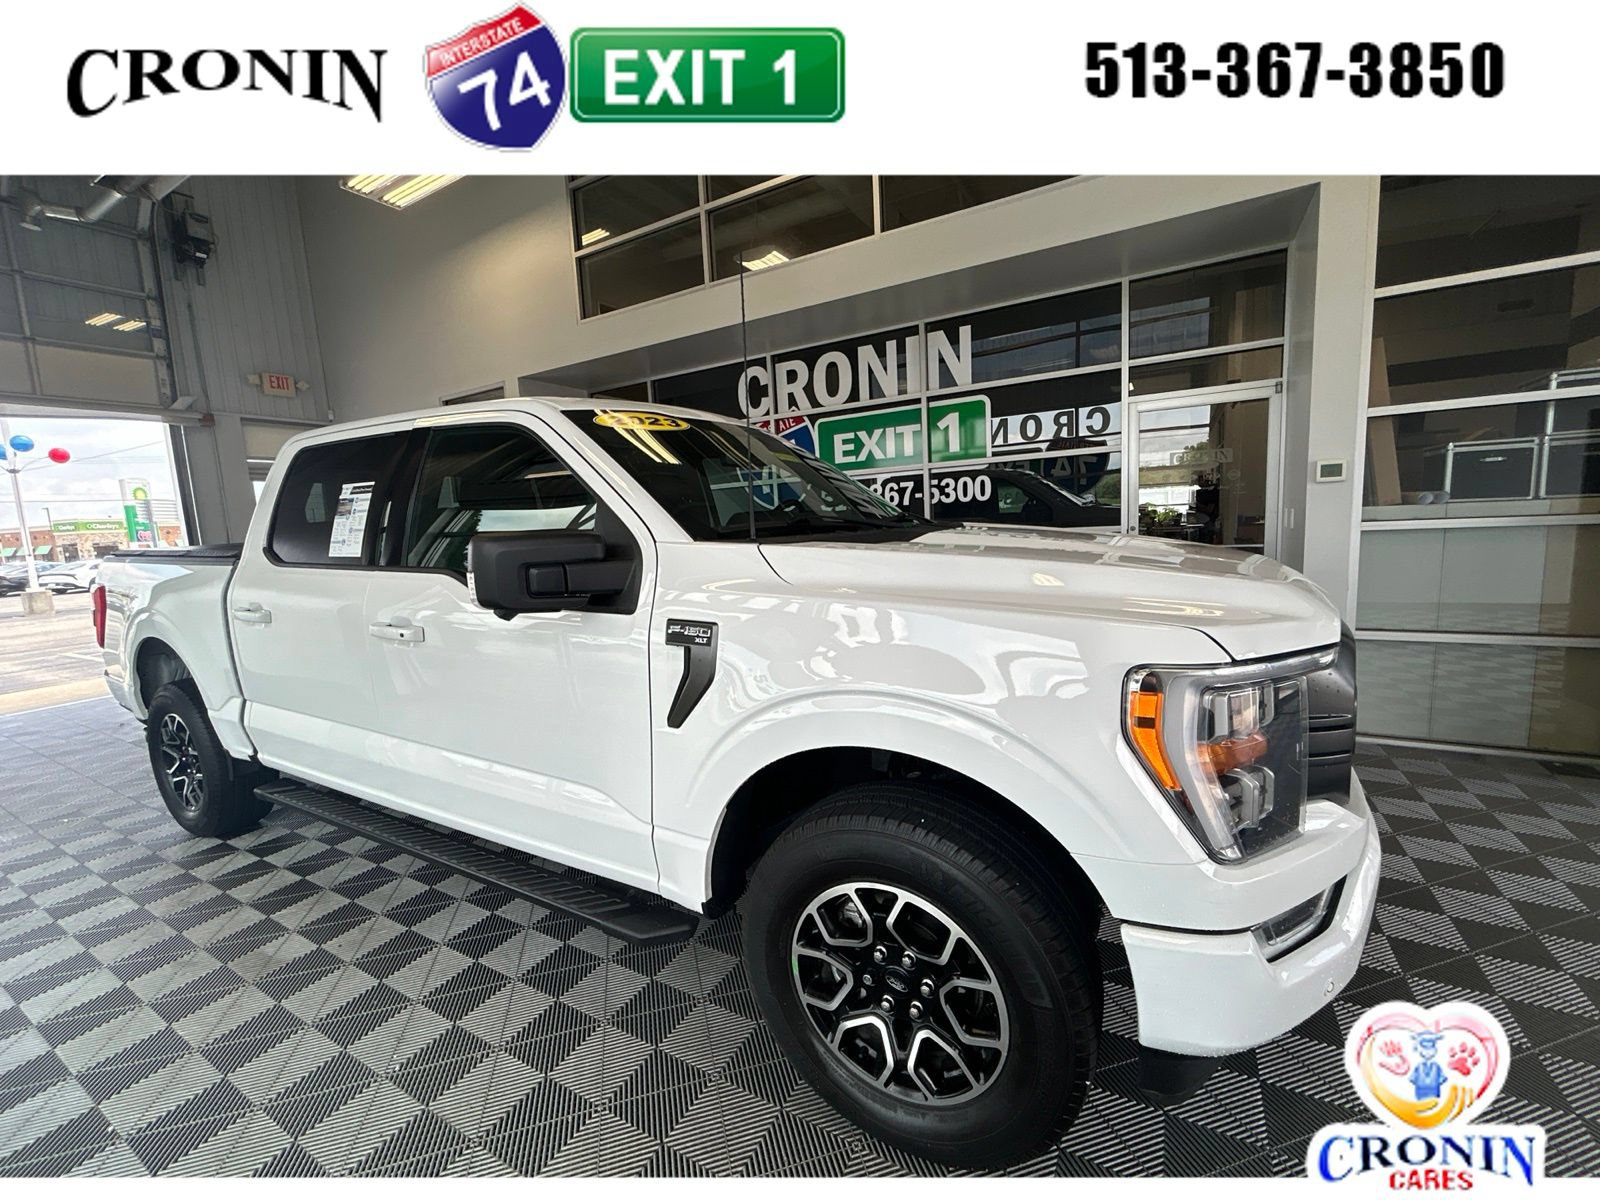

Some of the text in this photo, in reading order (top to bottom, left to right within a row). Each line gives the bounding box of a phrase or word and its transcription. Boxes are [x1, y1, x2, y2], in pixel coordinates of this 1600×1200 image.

[738, 325, 973, 417] CRONIN
[269, 375, 289, 391] EXIT
[609, 415, 682, 428] 2023
[834, 412, 961, 464] EXIT 1
[668, 625, 711, 637] F-150
